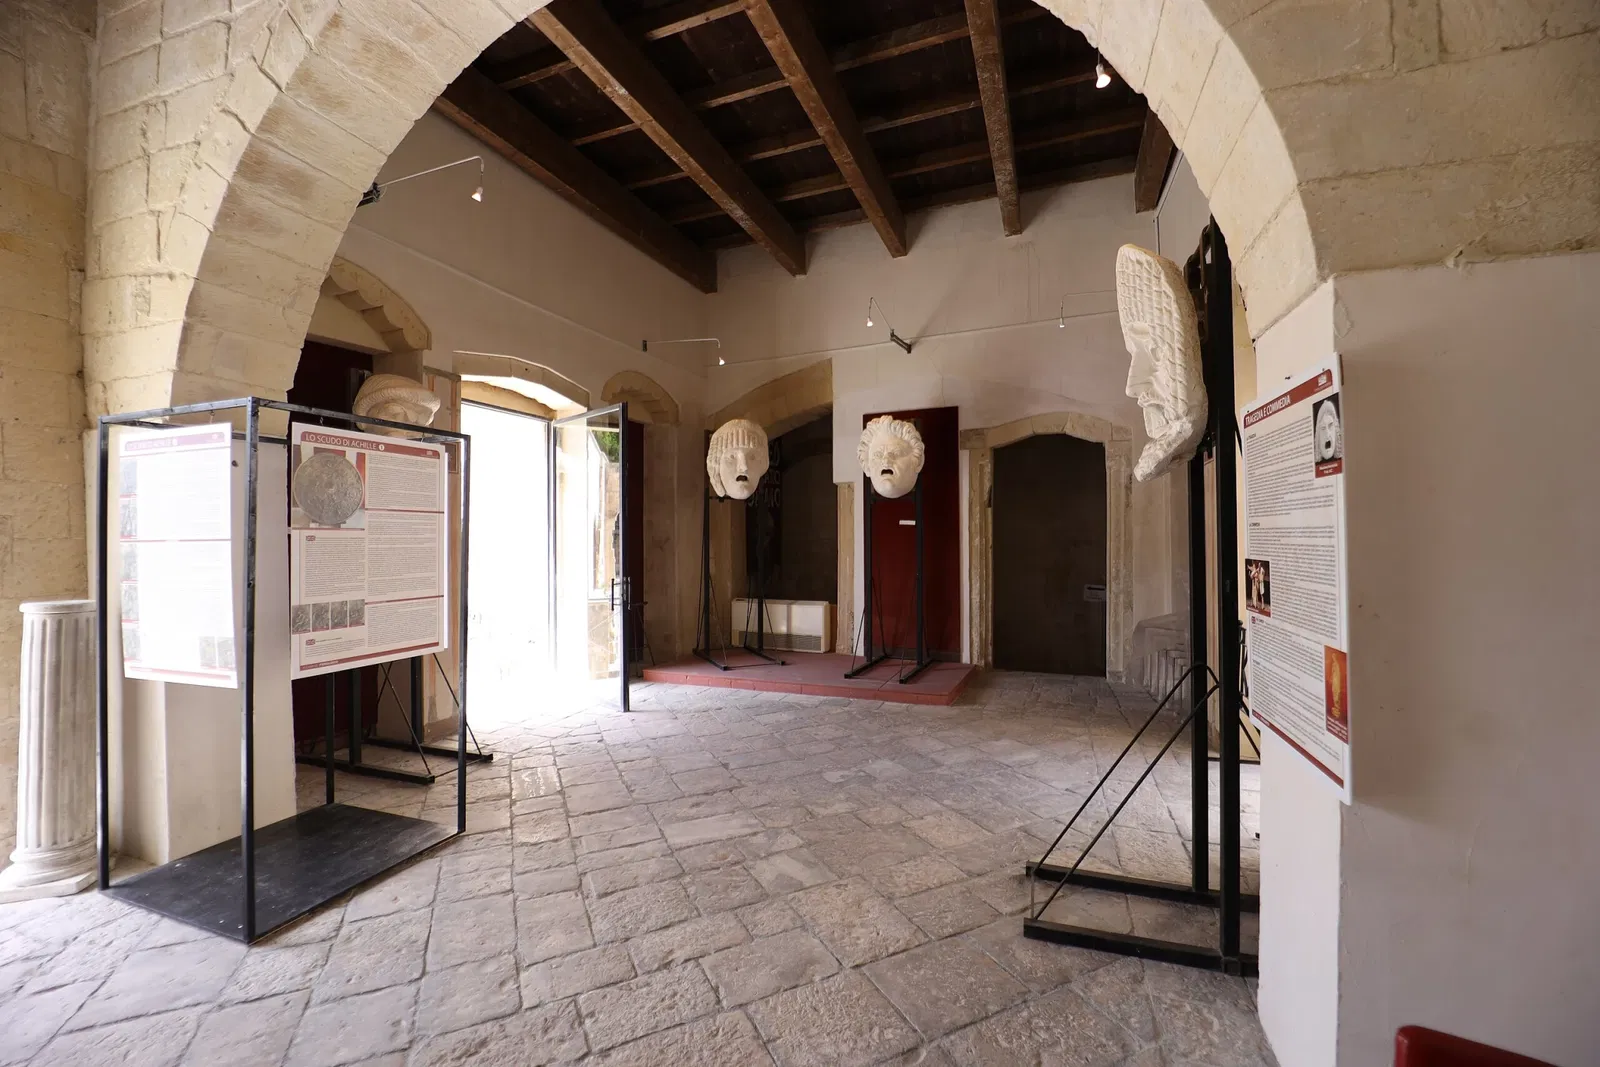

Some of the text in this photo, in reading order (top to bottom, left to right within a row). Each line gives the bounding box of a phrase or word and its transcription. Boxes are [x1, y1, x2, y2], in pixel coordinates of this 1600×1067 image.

[1245, 410, 1263, 425] TRAGEDIA
[1266, 395, 1290, 415] COMMEDIA
[305, 433, 316, 442] LO
[317, 435, 341, 445] SCUDO
[342, 438, 350, 446] DI
[351, 440, 376, 450] ACHILLE
